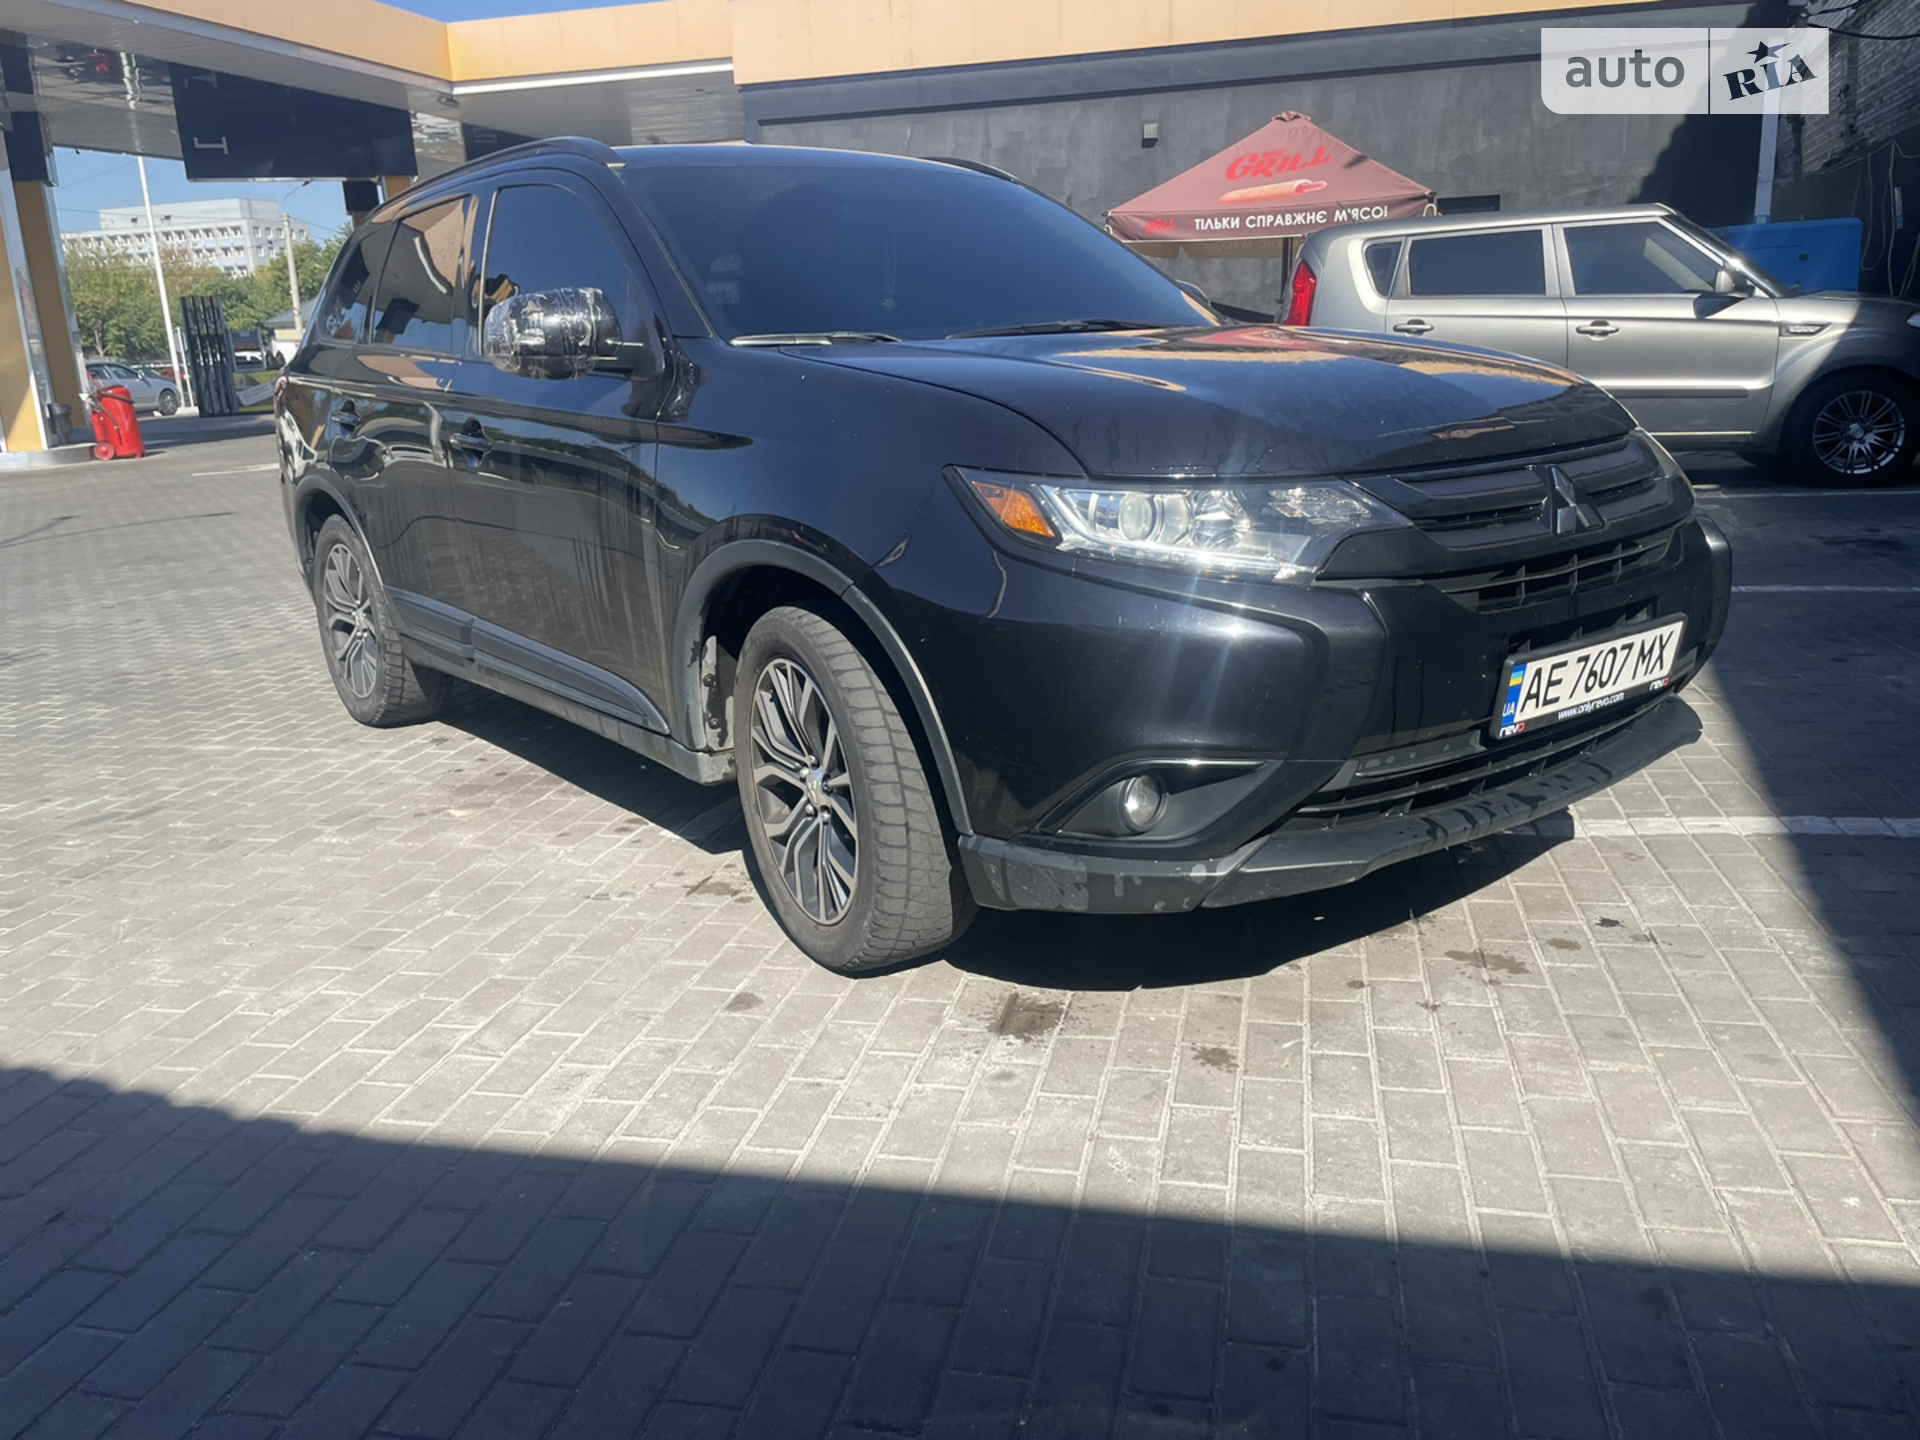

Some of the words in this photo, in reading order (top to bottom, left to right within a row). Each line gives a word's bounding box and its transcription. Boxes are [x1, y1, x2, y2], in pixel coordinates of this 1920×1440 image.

[1226, 146, 1332, 181] GRILL
[1194, 215, 1241, 231] ТІЛЬКИ
[1245, 209, 1328, 229] СПРАВЖНЄ
[1333, 204, 1389, 223] М'ЯСО!
[1520, 660, 1568, 713] AE
[1569, 642, 1635, 699] 7607
[1632, 630, 1674, 680] MX
[1502, 703, 1516, 717] UA
[1558, 692, 1624, 720] www.onlyrevo.com
[1499, 722, 1526, 738] revo
